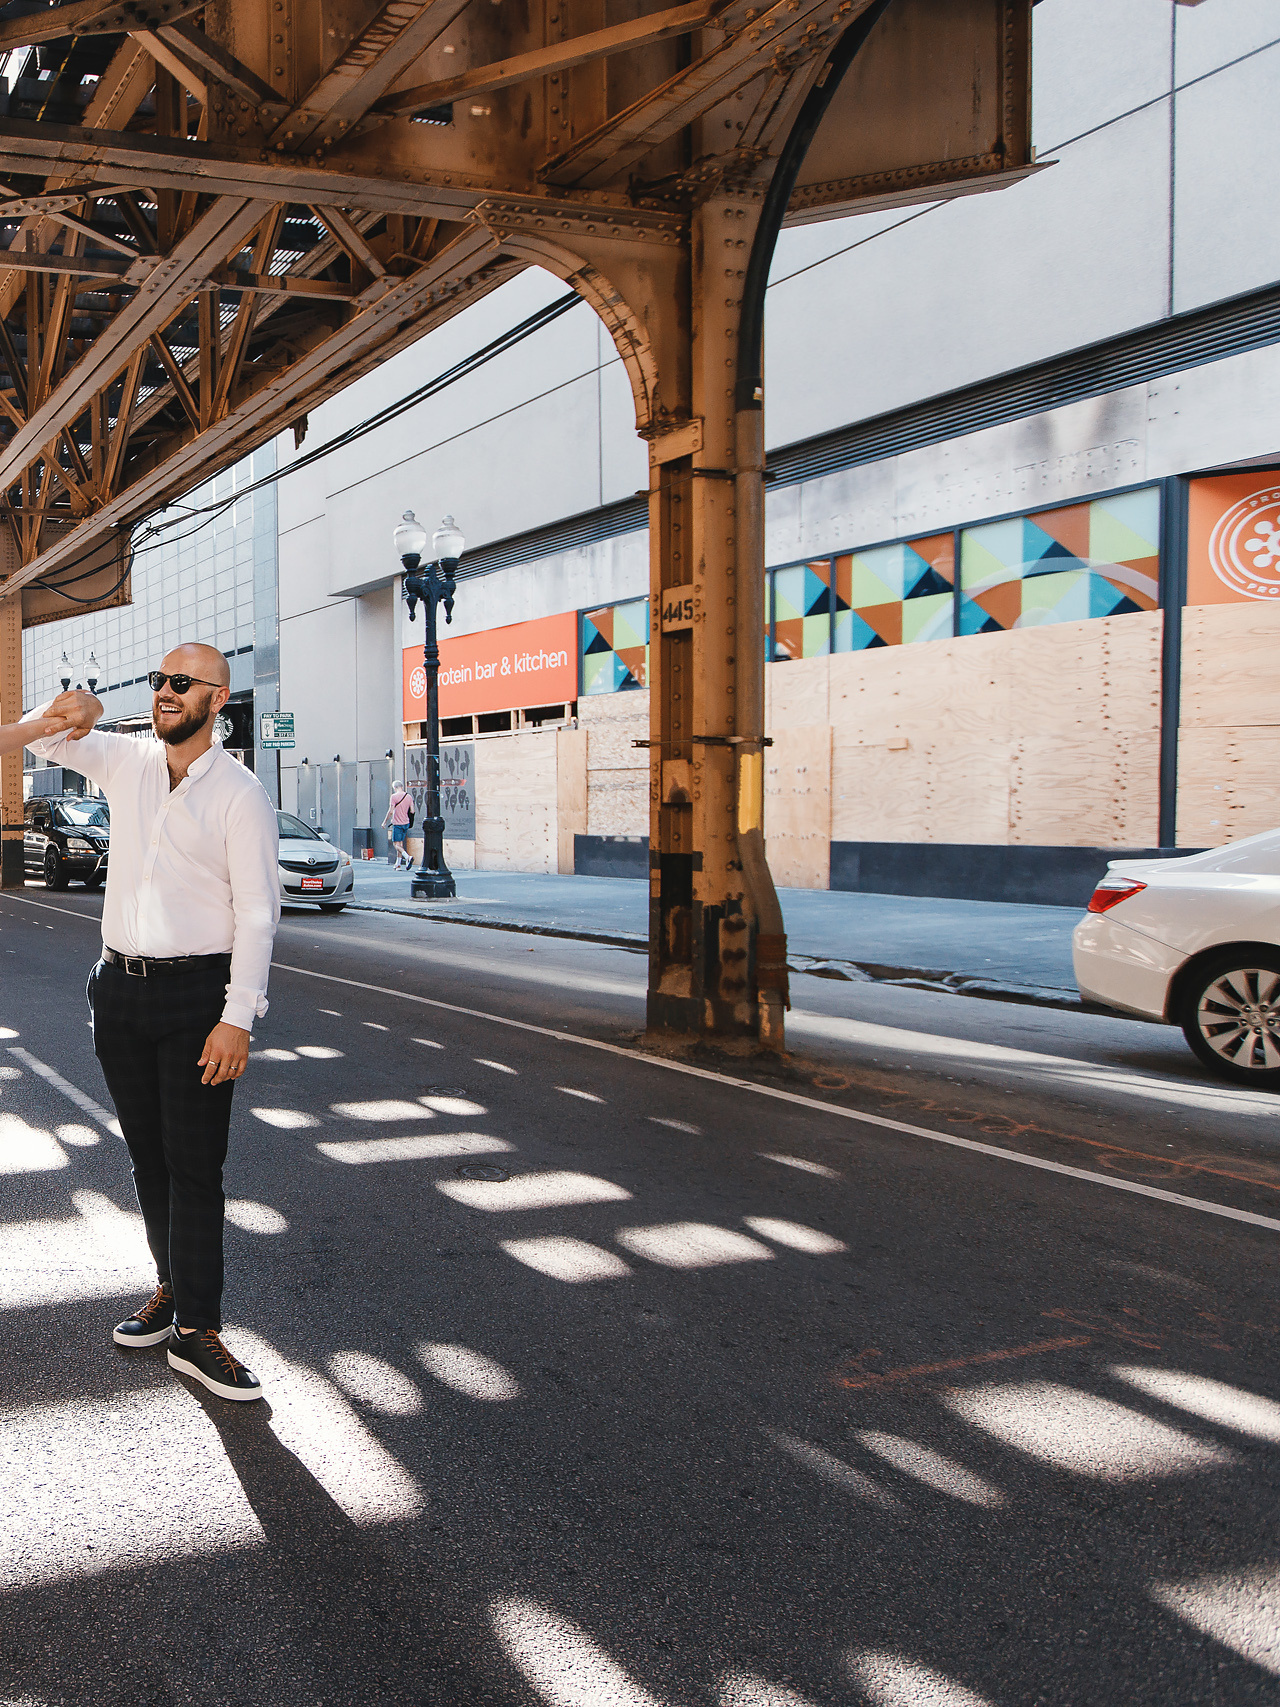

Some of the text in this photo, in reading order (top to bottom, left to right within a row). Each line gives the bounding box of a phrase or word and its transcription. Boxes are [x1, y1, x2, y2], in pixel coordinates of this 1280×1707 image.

[662, 599, 693, 622] 445
[437, 649, 568, 687] rotein bar & kitchen
